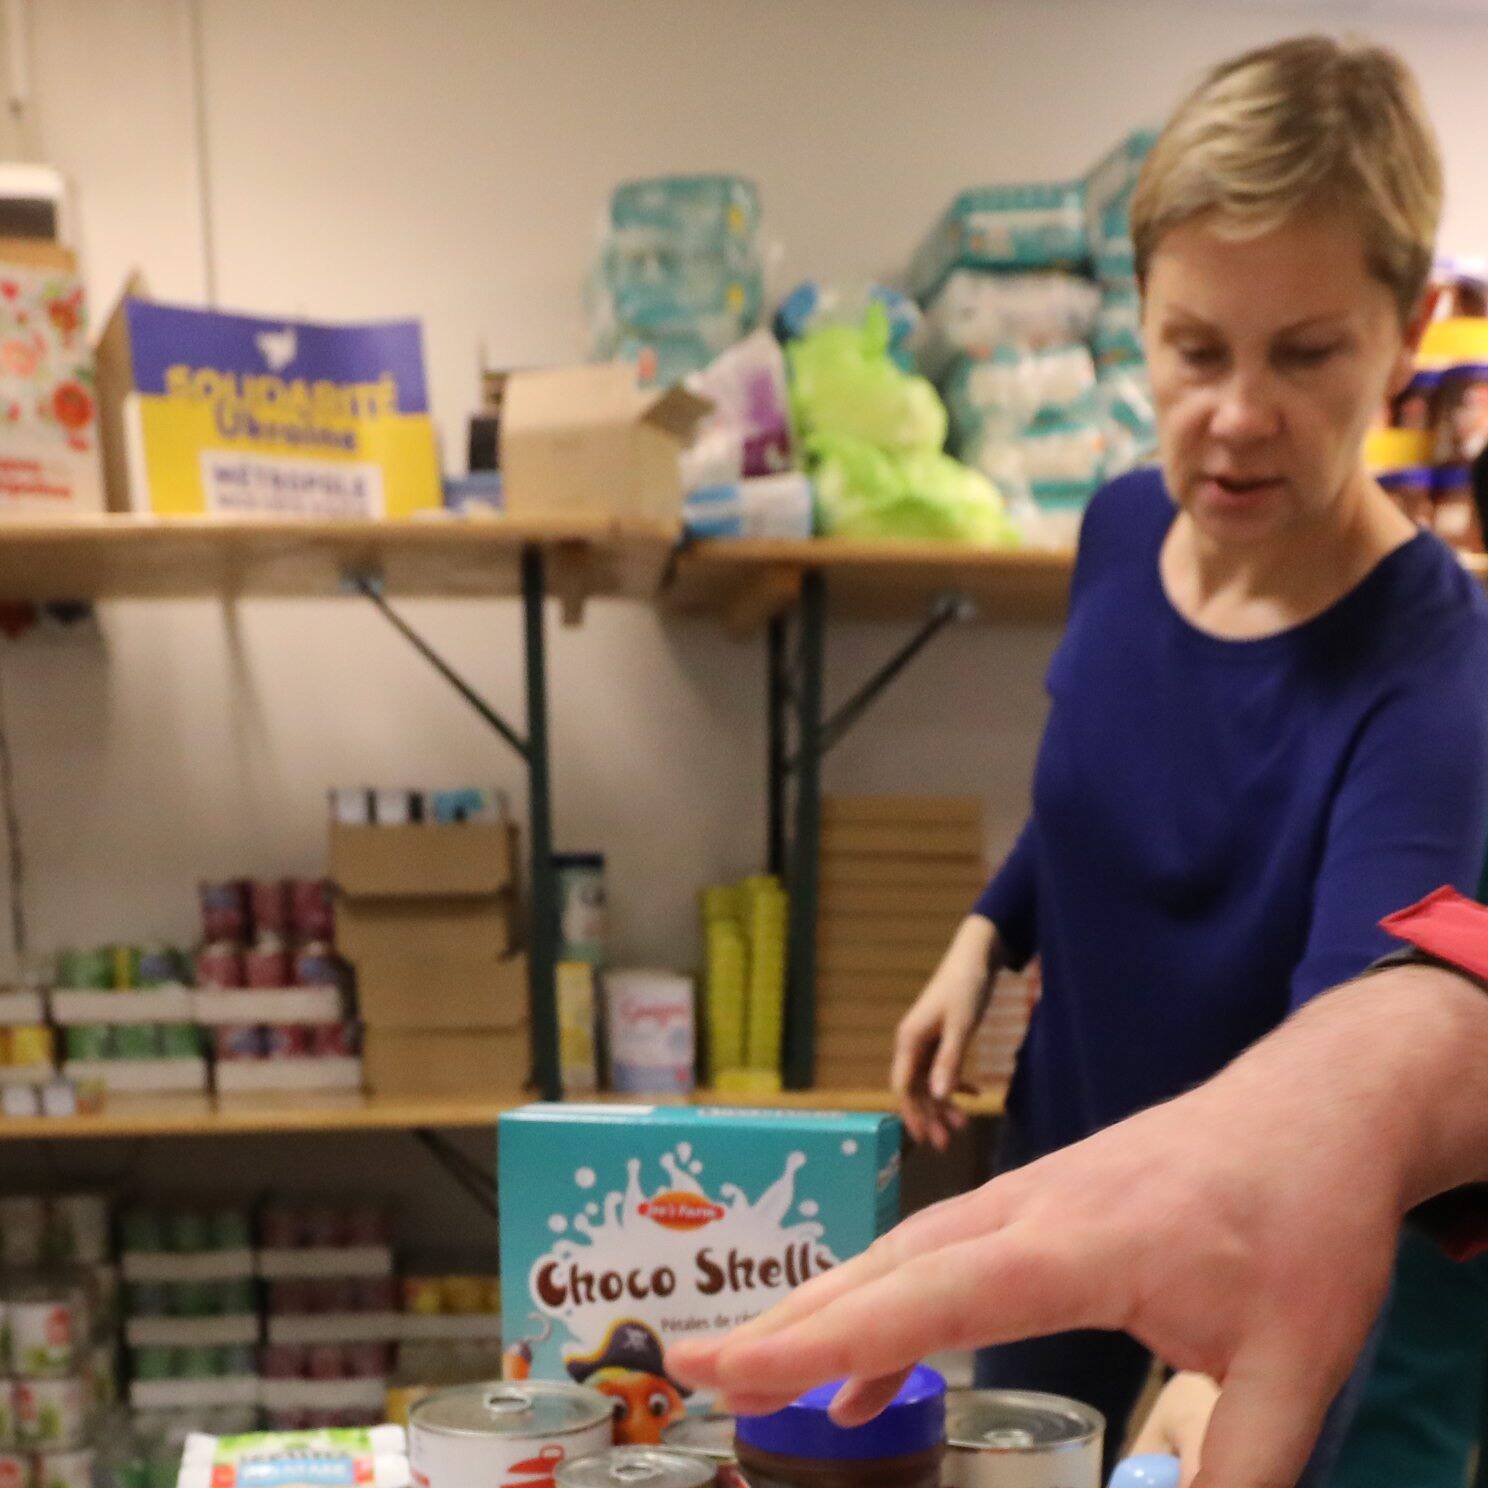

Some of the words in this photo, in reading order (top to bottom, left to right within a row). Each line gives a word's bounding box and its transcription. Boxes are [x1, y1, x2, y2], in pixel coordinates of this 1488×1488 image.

[215, 400, 359, 453] Ukraine
[536, 1259, 677, 1307] Choco
[694, 1241, 832, 1296] Shells
